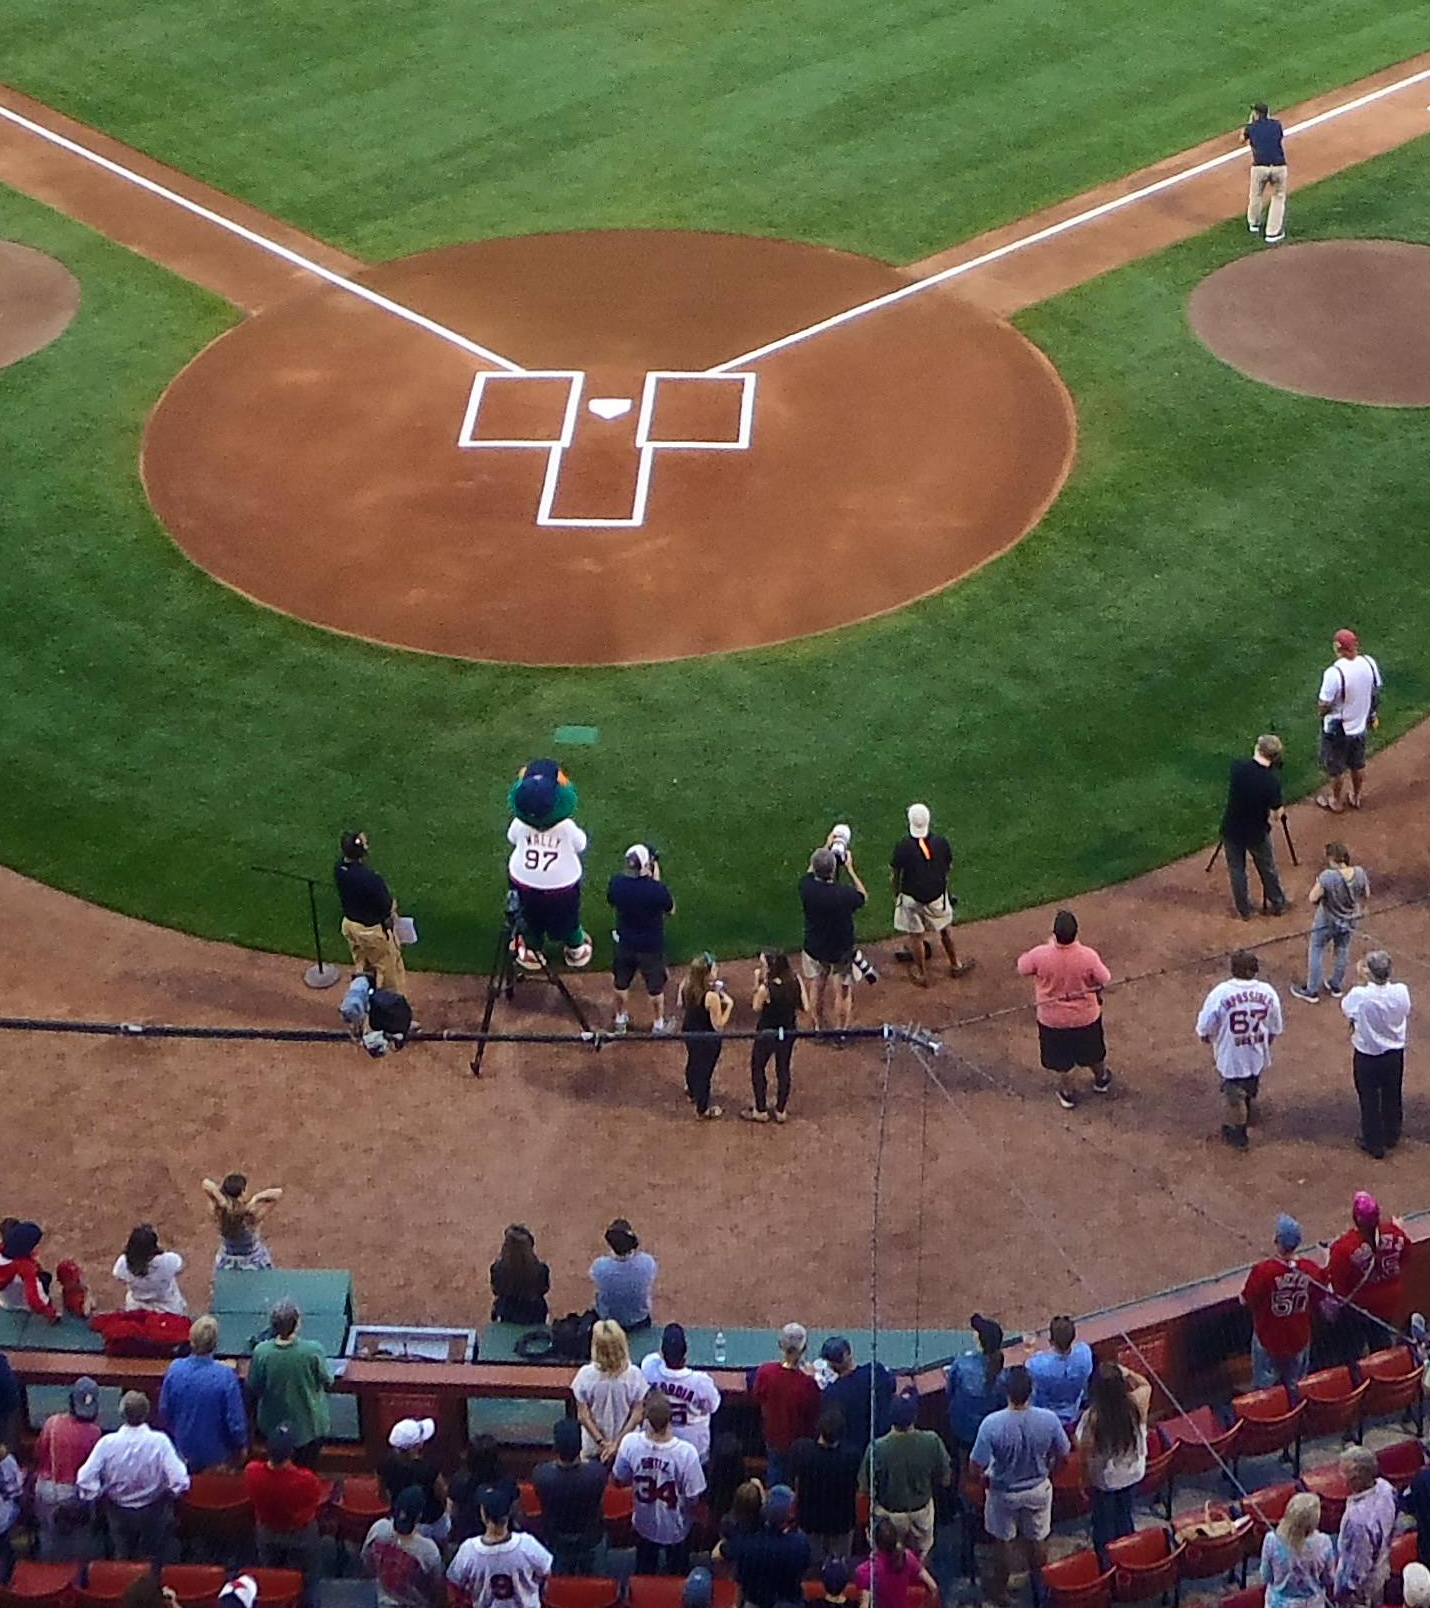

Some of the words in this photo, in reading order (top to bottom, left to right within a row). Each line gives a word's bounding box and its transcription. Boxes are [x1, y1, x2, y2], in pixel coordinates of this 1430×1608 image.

[524, 832, 560, 848] WALLY
[524, 849, 556, 872] 97
[1229, 1010, 1266, 1034] 67
[1269, 1290, 1309, 1318] 50
[638, 1457, 668, 1472] ORTIZ
[632, 1475, 678, 1509] 34
